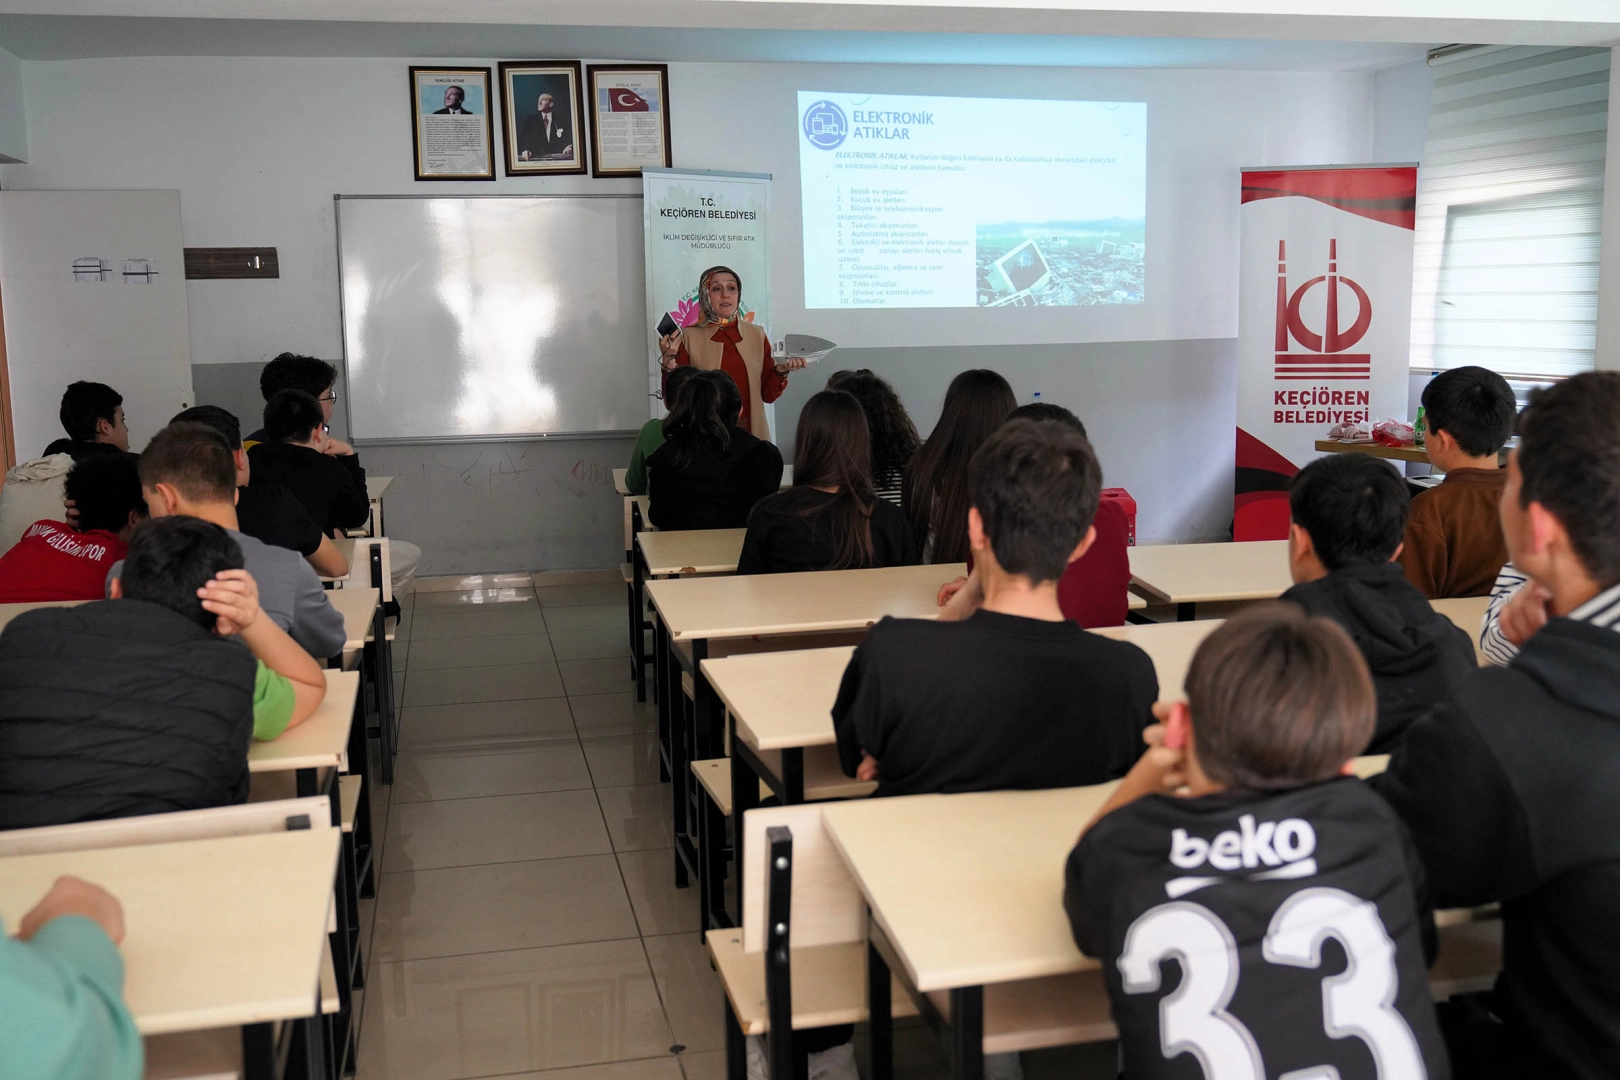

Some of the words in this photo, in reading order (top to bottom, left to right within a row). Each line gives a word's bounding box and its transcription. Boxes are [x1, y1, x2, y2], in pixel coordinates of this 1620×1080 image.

[853, 110, 934, 124] ELEKTRONİK
[853, 127, 910, 140] ATIKLAR
[700, 198, 716, 206] T.C.
[660, 208, 706, 219] KEÇİÖREN
[708, 210, 756, 220] BELEDİYESİ
[1274, 386, 1370, 408] KEÇİÖREN
[1274, 407, 1369, 424] BELEDİYESİ
[1170, 814, 1316, 870] beko
